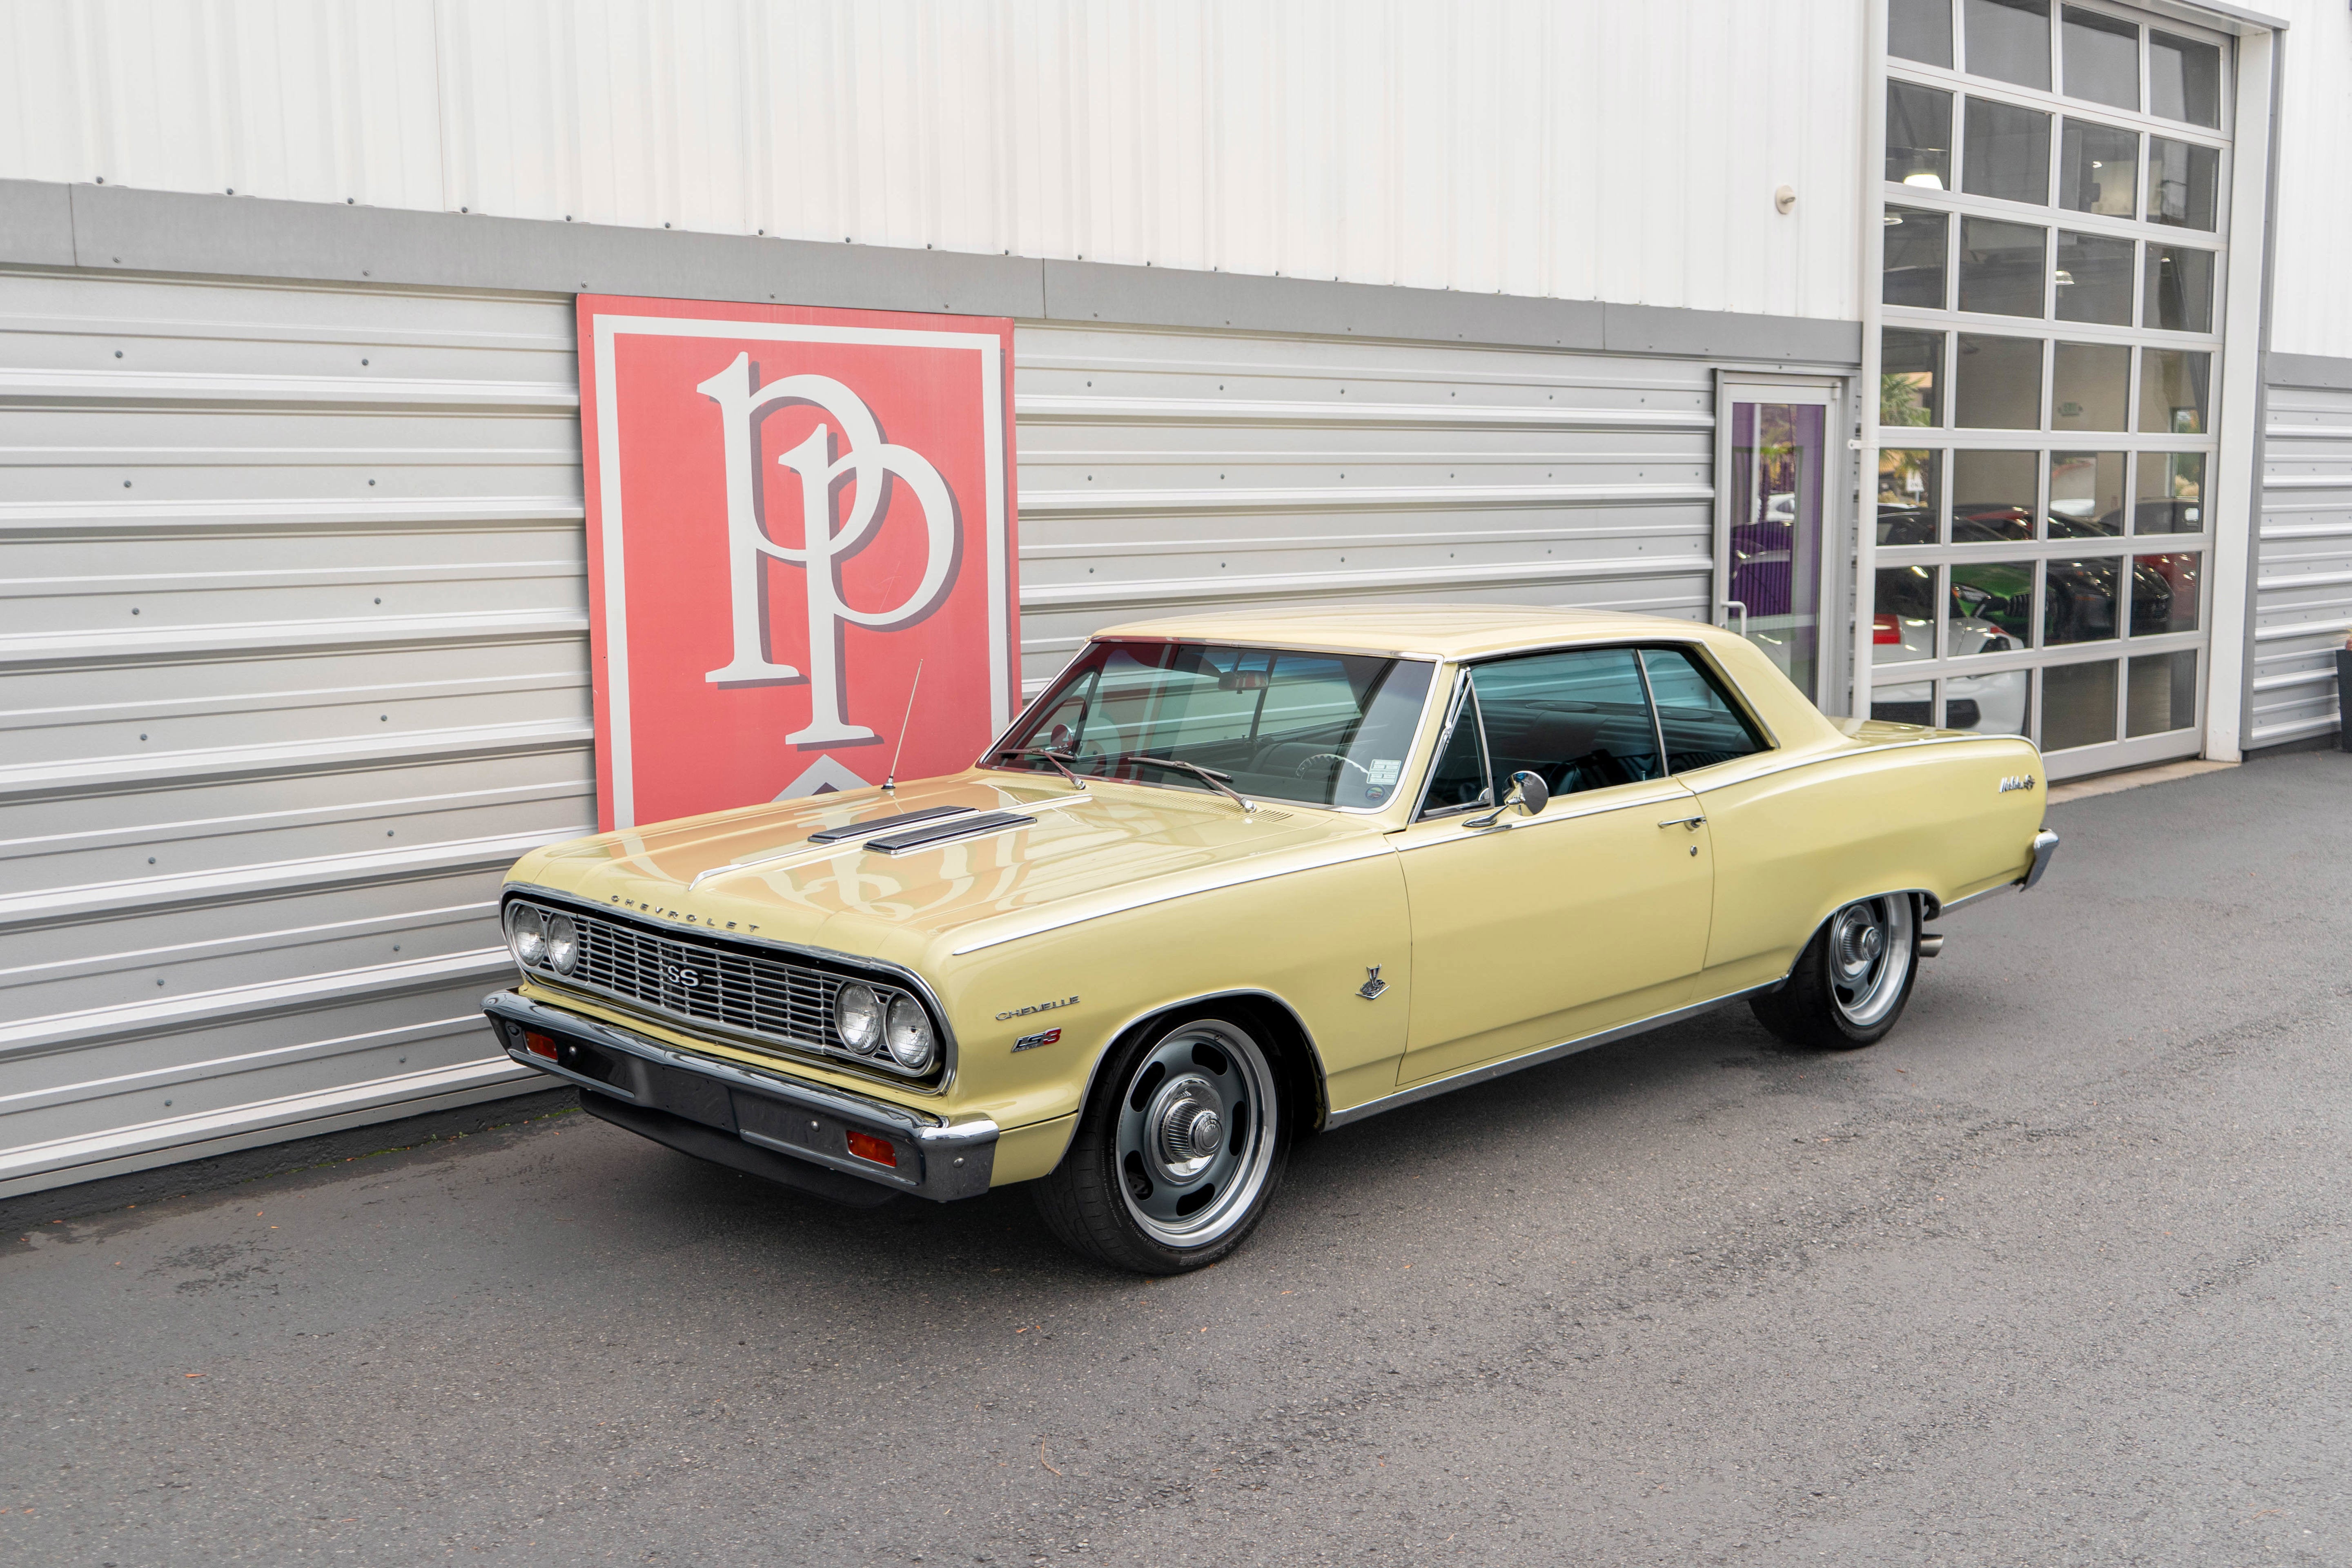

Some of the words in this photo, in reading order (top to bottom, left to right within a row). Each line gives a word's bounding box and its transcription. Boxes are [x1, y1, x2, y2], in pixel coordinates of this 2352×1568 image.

[611, 895, 760, 932] CHEVROLET
[668, 965, 699, 987] SS
[996, 995, 1080, 1020] CHEVELLE
[1013, 1027, 1062, 1050] LS3
